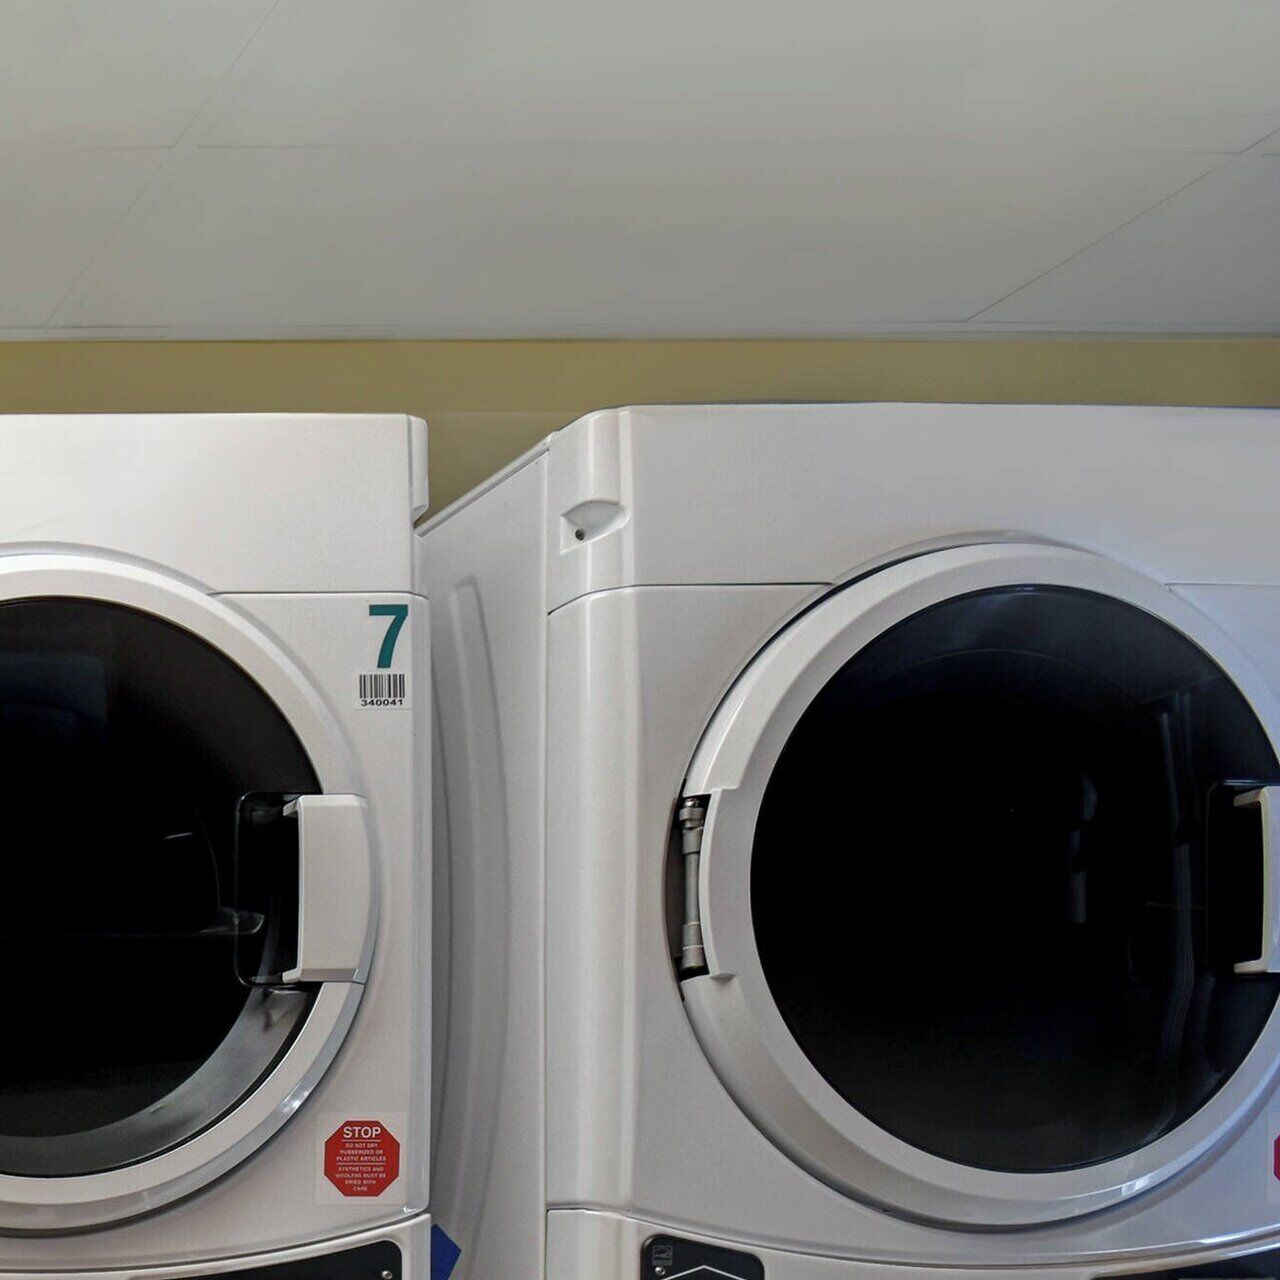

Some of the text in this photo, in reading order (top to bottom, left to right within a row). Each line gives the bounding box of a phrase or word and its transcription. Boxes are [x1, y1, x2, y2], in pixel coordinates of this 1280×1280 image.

[368, 604, 409, 668] 7
[361, 699, 403, 707] 340041
[342, 1126, 381, 1138] STOP
